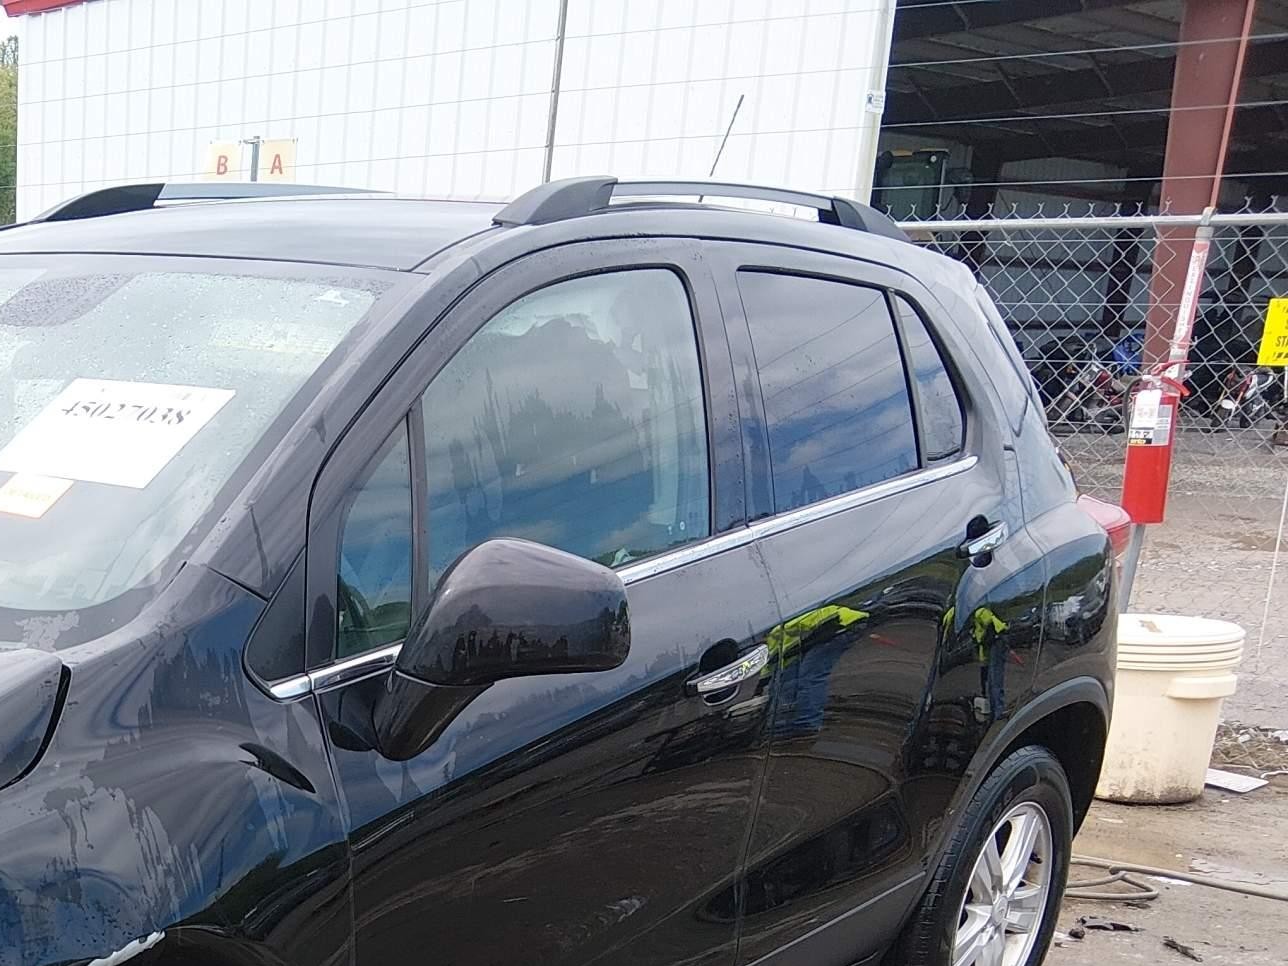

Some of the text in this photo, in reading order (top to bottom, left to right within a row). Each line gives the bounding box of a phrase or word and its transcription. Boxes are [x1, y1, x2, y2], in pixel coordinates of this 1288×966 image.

[216, 155, 228, 175] B
[270, 154, 283, 174] A
[62, 400, 191, 425] 45027038
